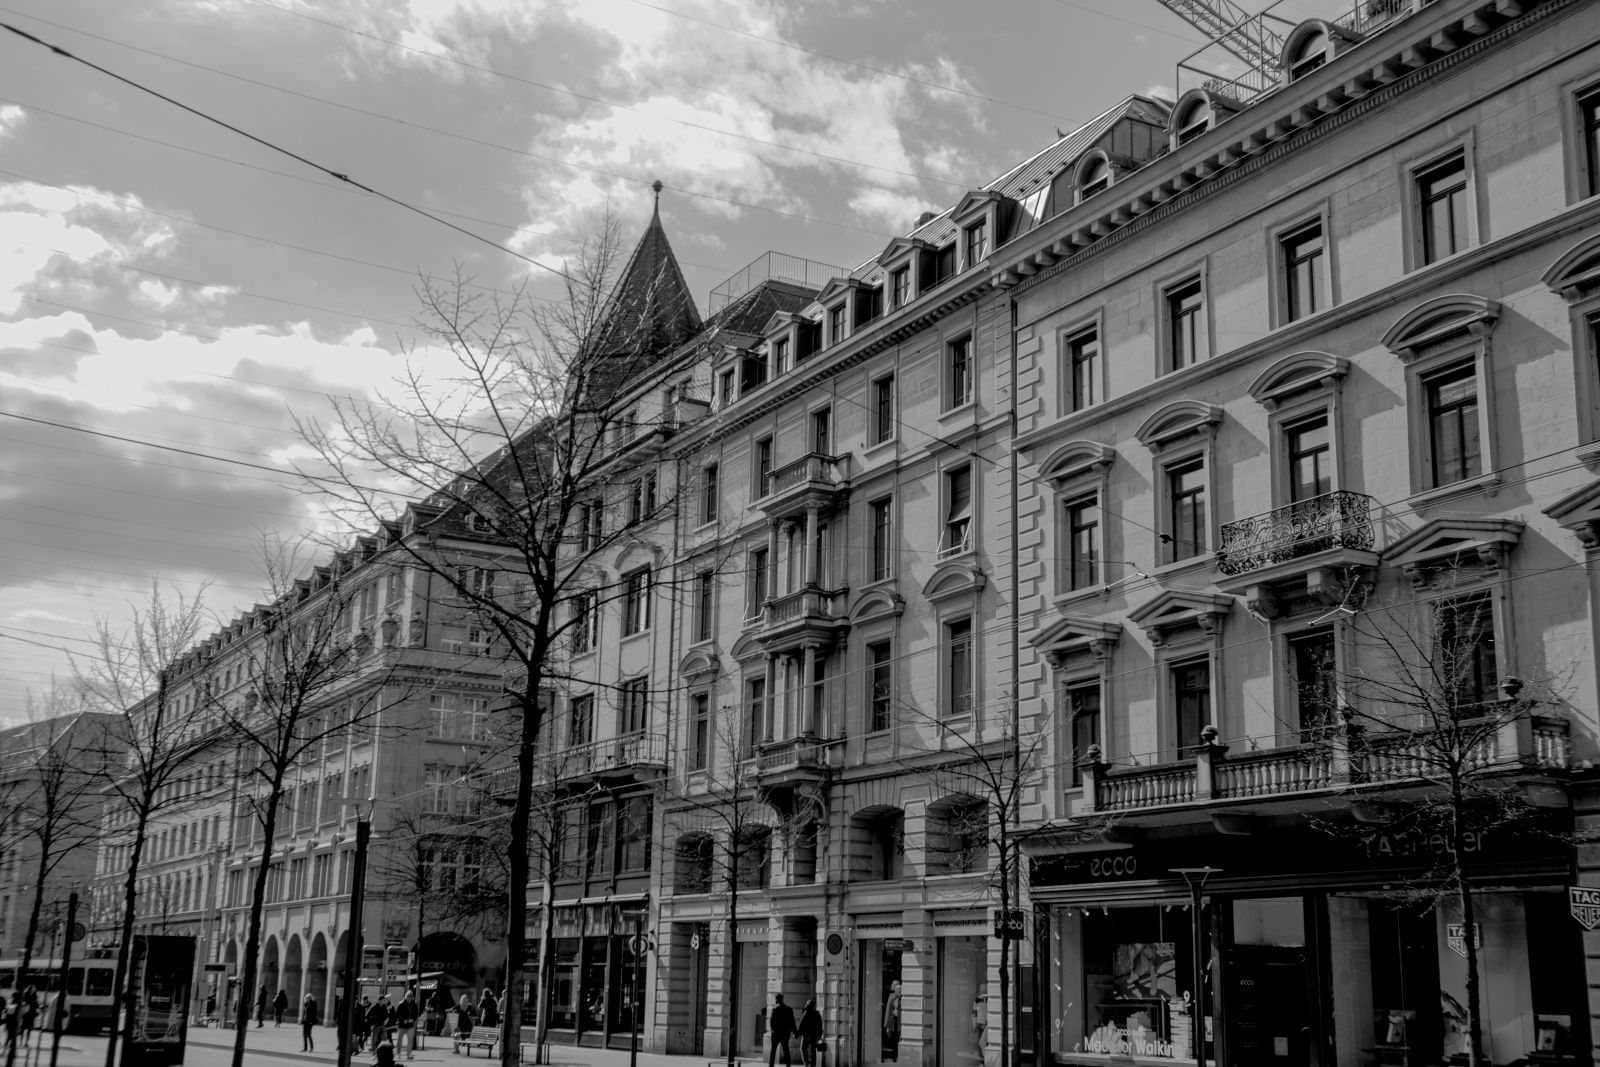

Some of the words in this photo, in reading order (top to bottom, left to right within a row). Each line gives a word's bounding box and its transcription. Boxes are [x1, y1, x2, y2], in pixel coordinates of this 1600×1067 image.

[1089, 855, 1137, 878] ecco
[1572, 890, 1600, 904] TAG
[1450, 926, 1476, 937] TA
